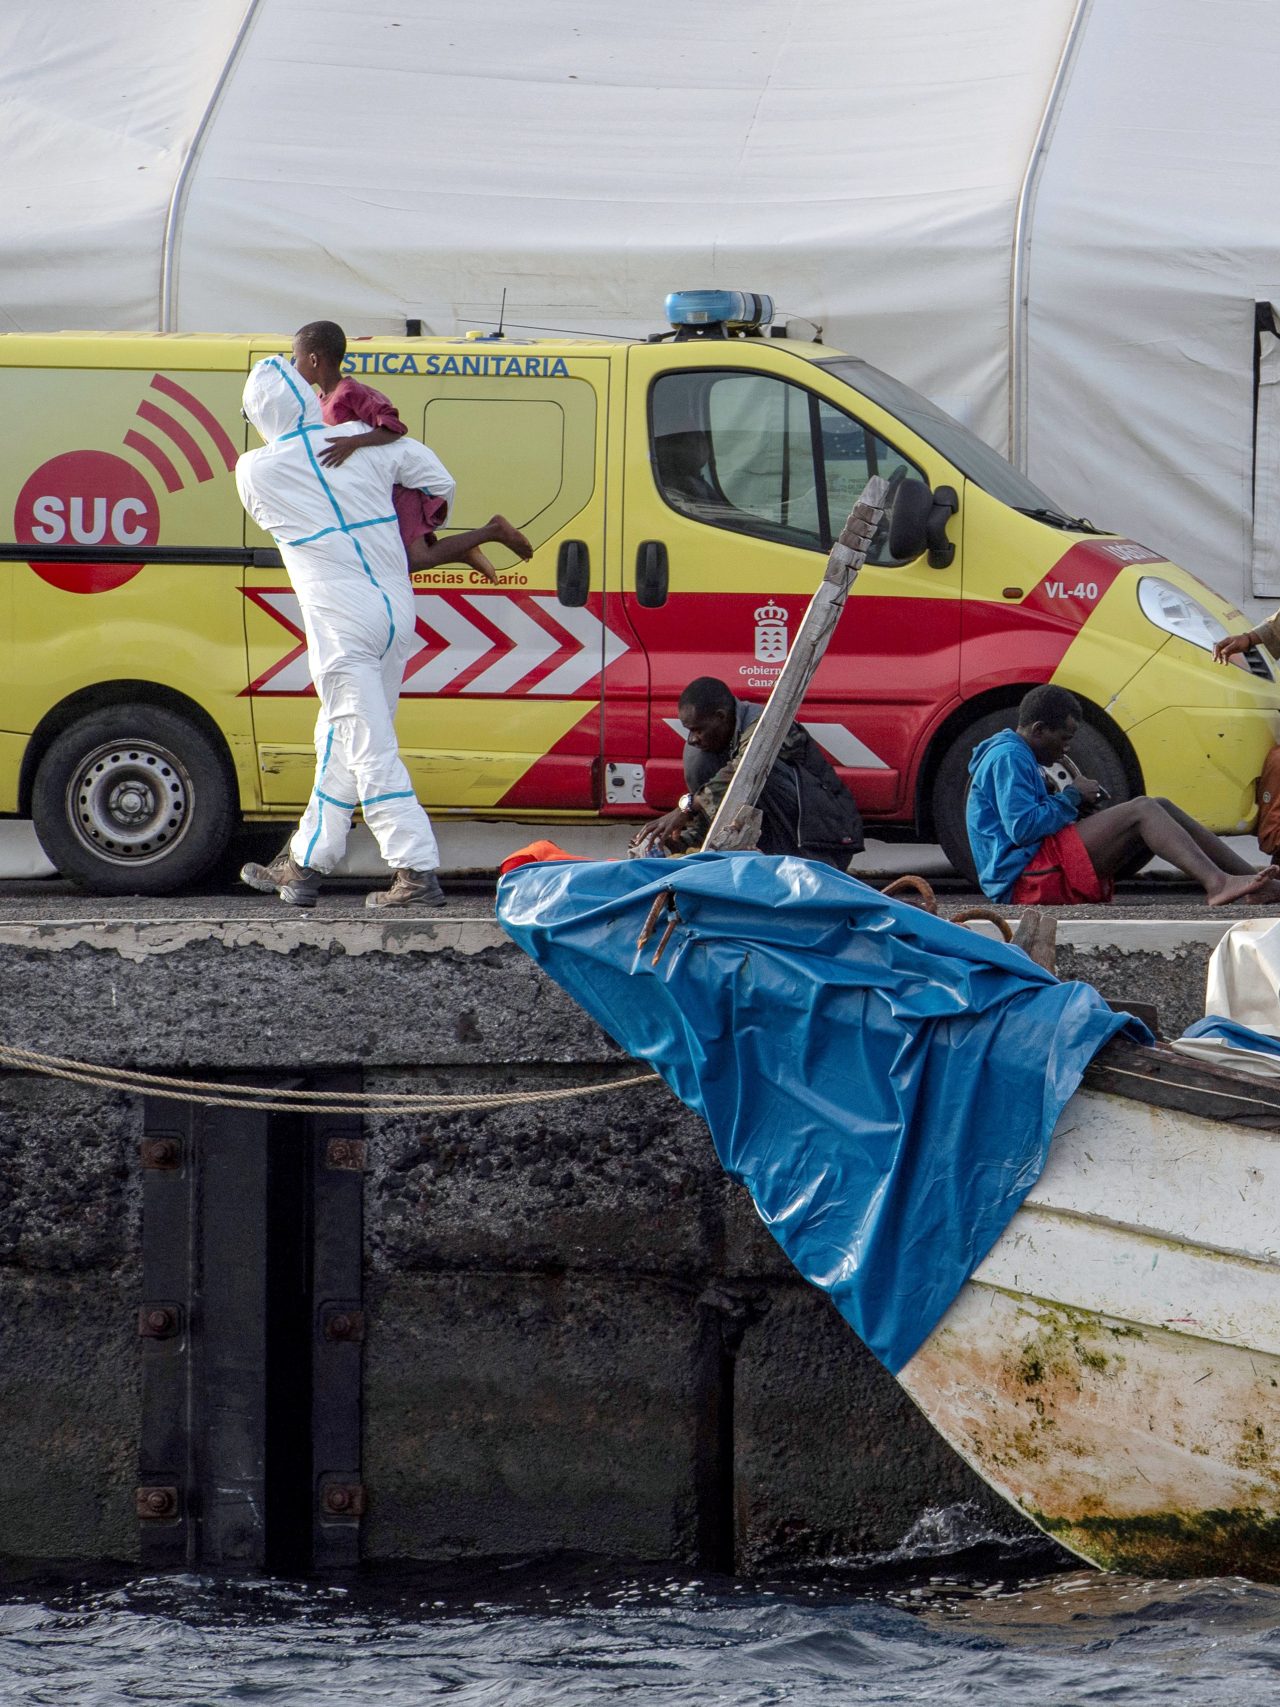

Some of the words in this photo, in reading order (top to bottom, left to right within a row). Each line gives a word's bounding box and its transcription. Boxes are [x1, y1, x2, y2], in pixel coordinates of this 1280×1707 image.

[426, 354, 570, 377] SANITARIA
[31, 495, 149, 546] SUC
[1044, 581, 1098, 600] VL-40
[739, 665, 782, 675] Gobiern
